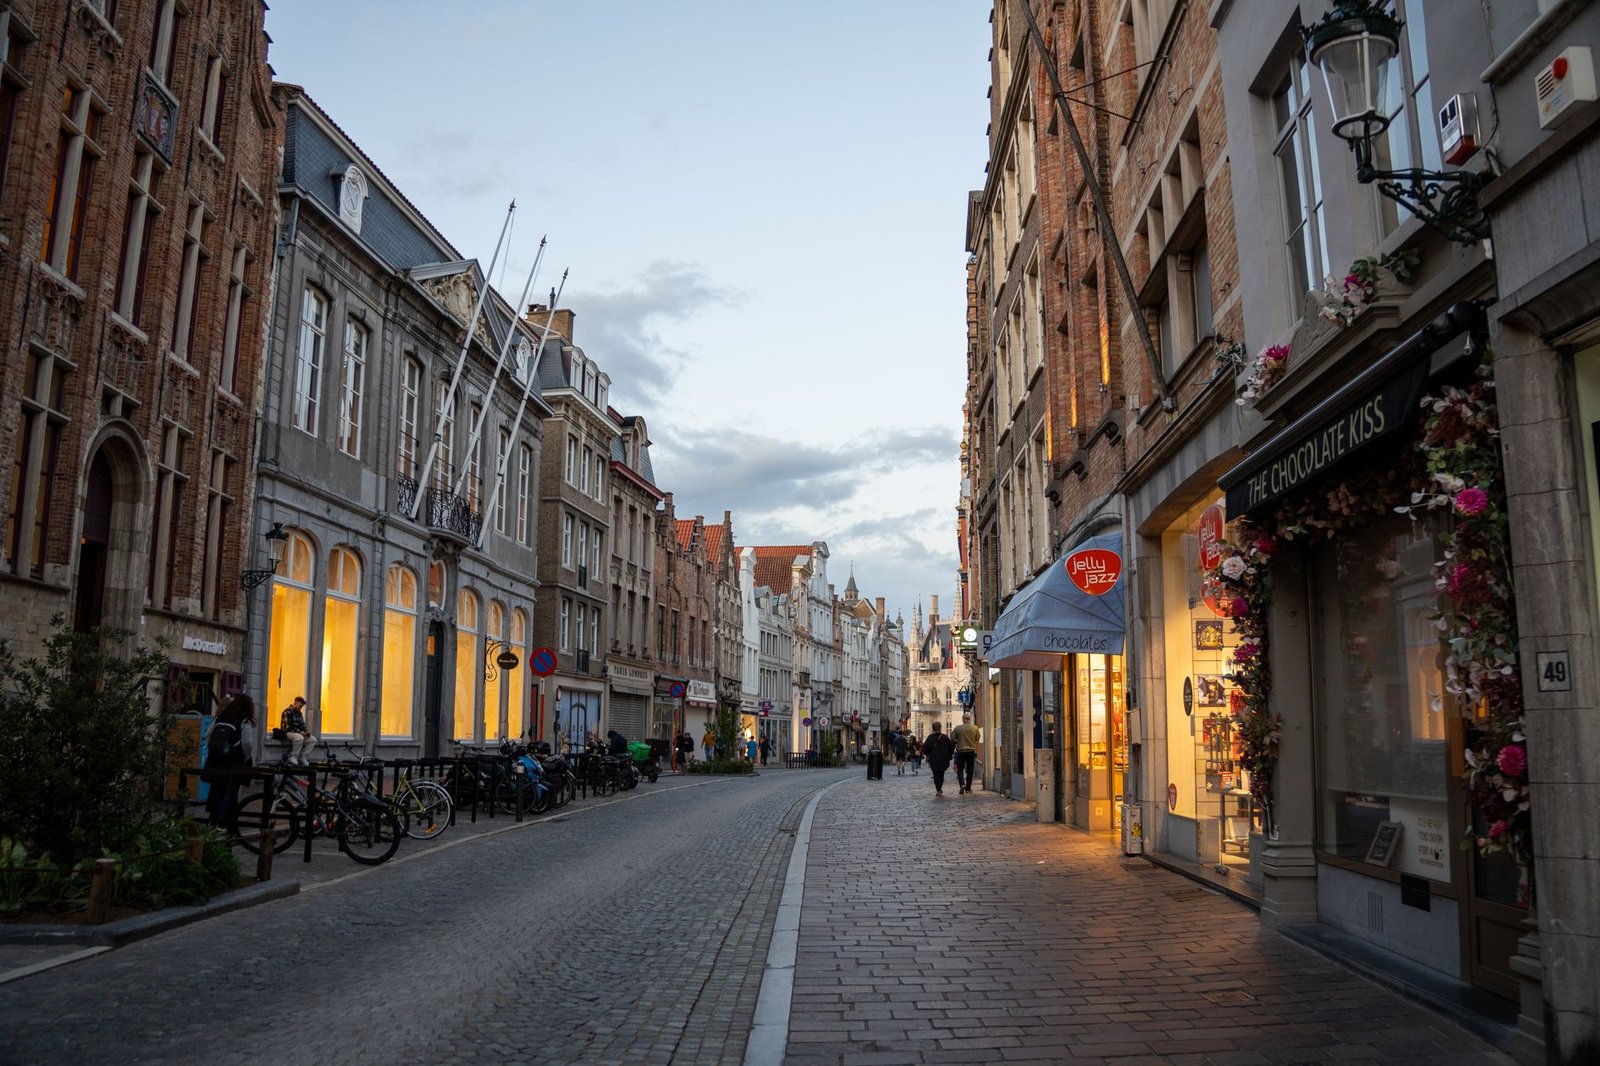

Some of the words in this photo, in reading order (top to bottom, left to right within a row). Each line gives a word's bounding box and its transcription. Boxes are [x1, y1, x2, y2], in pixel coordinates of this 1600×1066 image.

[1247, 470, 1268, 506] THE
[1270, 419, 1346, 494] CHOCOLATE
[1349, 394, 1386, 449] KISS
[1200, 518, 1217, 550] jelly
[1071, 556, 1106, 575] jelly
[1084, 571, 1118, 588] jazz
[1044, 632, 1108, 651] chocolates
[1544, 661, 1566, 682] 49
